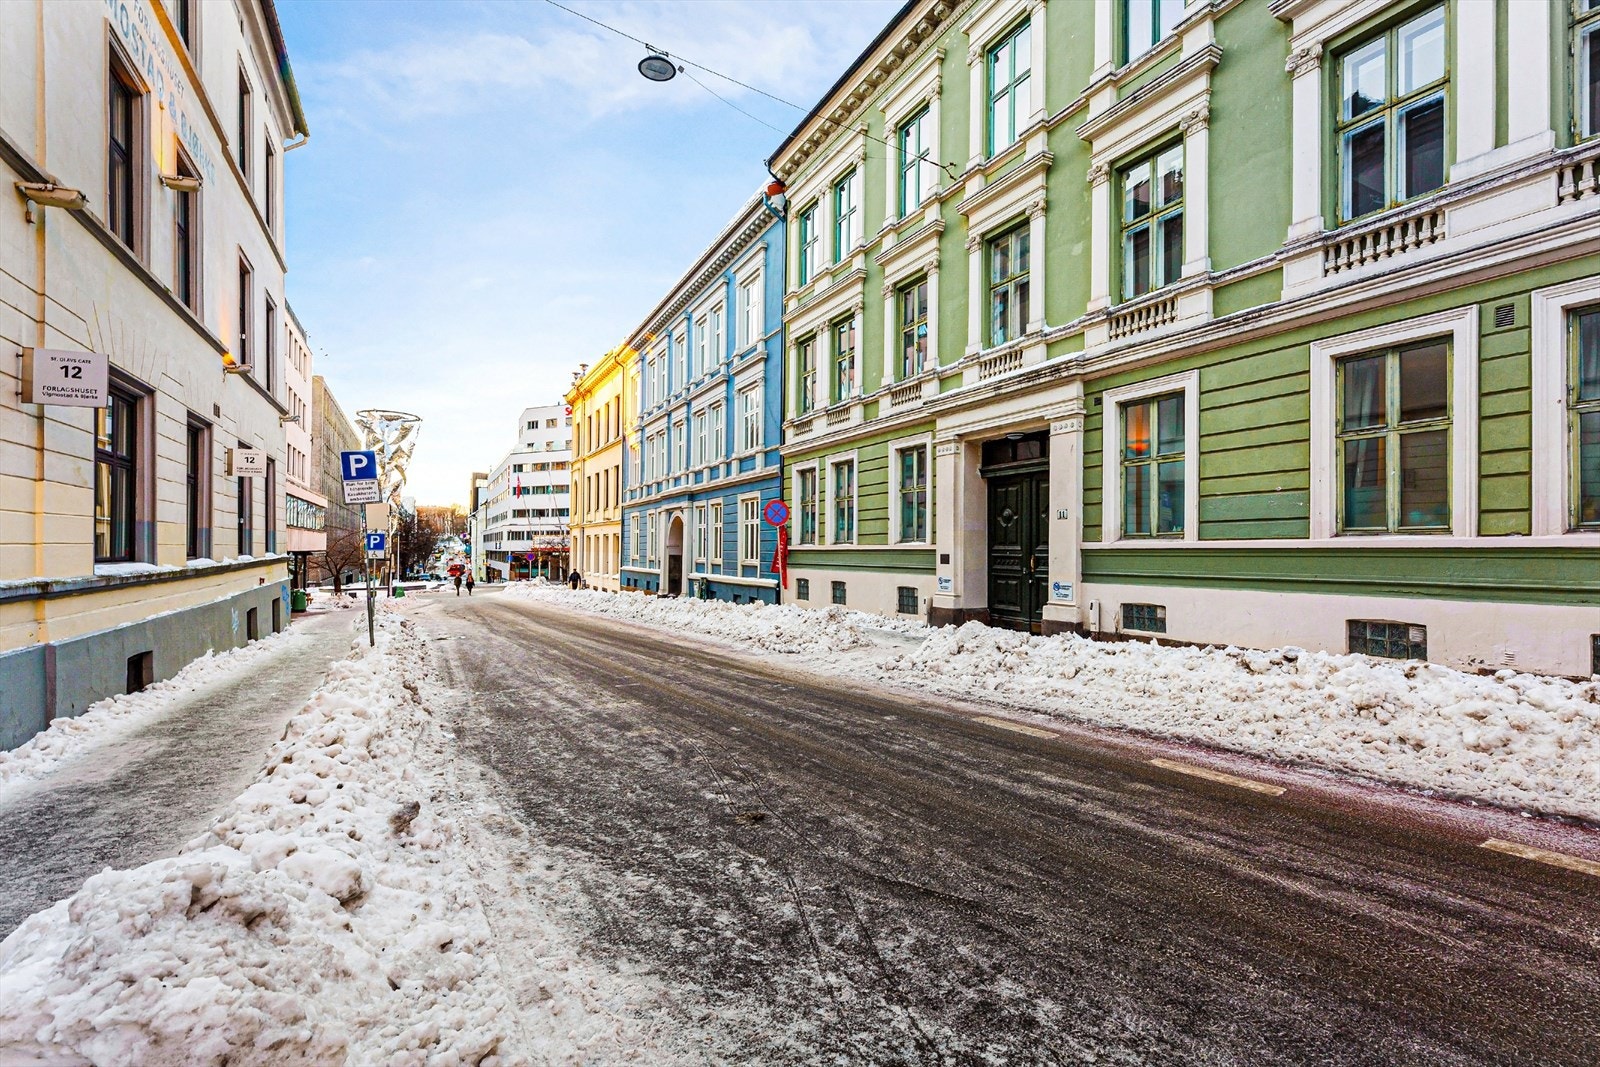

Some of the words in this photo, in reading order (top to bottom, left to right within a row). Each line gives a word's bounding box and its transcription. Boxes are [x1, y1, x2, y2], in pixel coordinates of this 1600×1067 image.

[60, 365, 82, 379] 12
[42, 385, 98, 394] FORLAGSHUSET
[244, 456, 256, 464] 12
[349, 454, 368, 477] P
[370, 535, 380, 549] P
